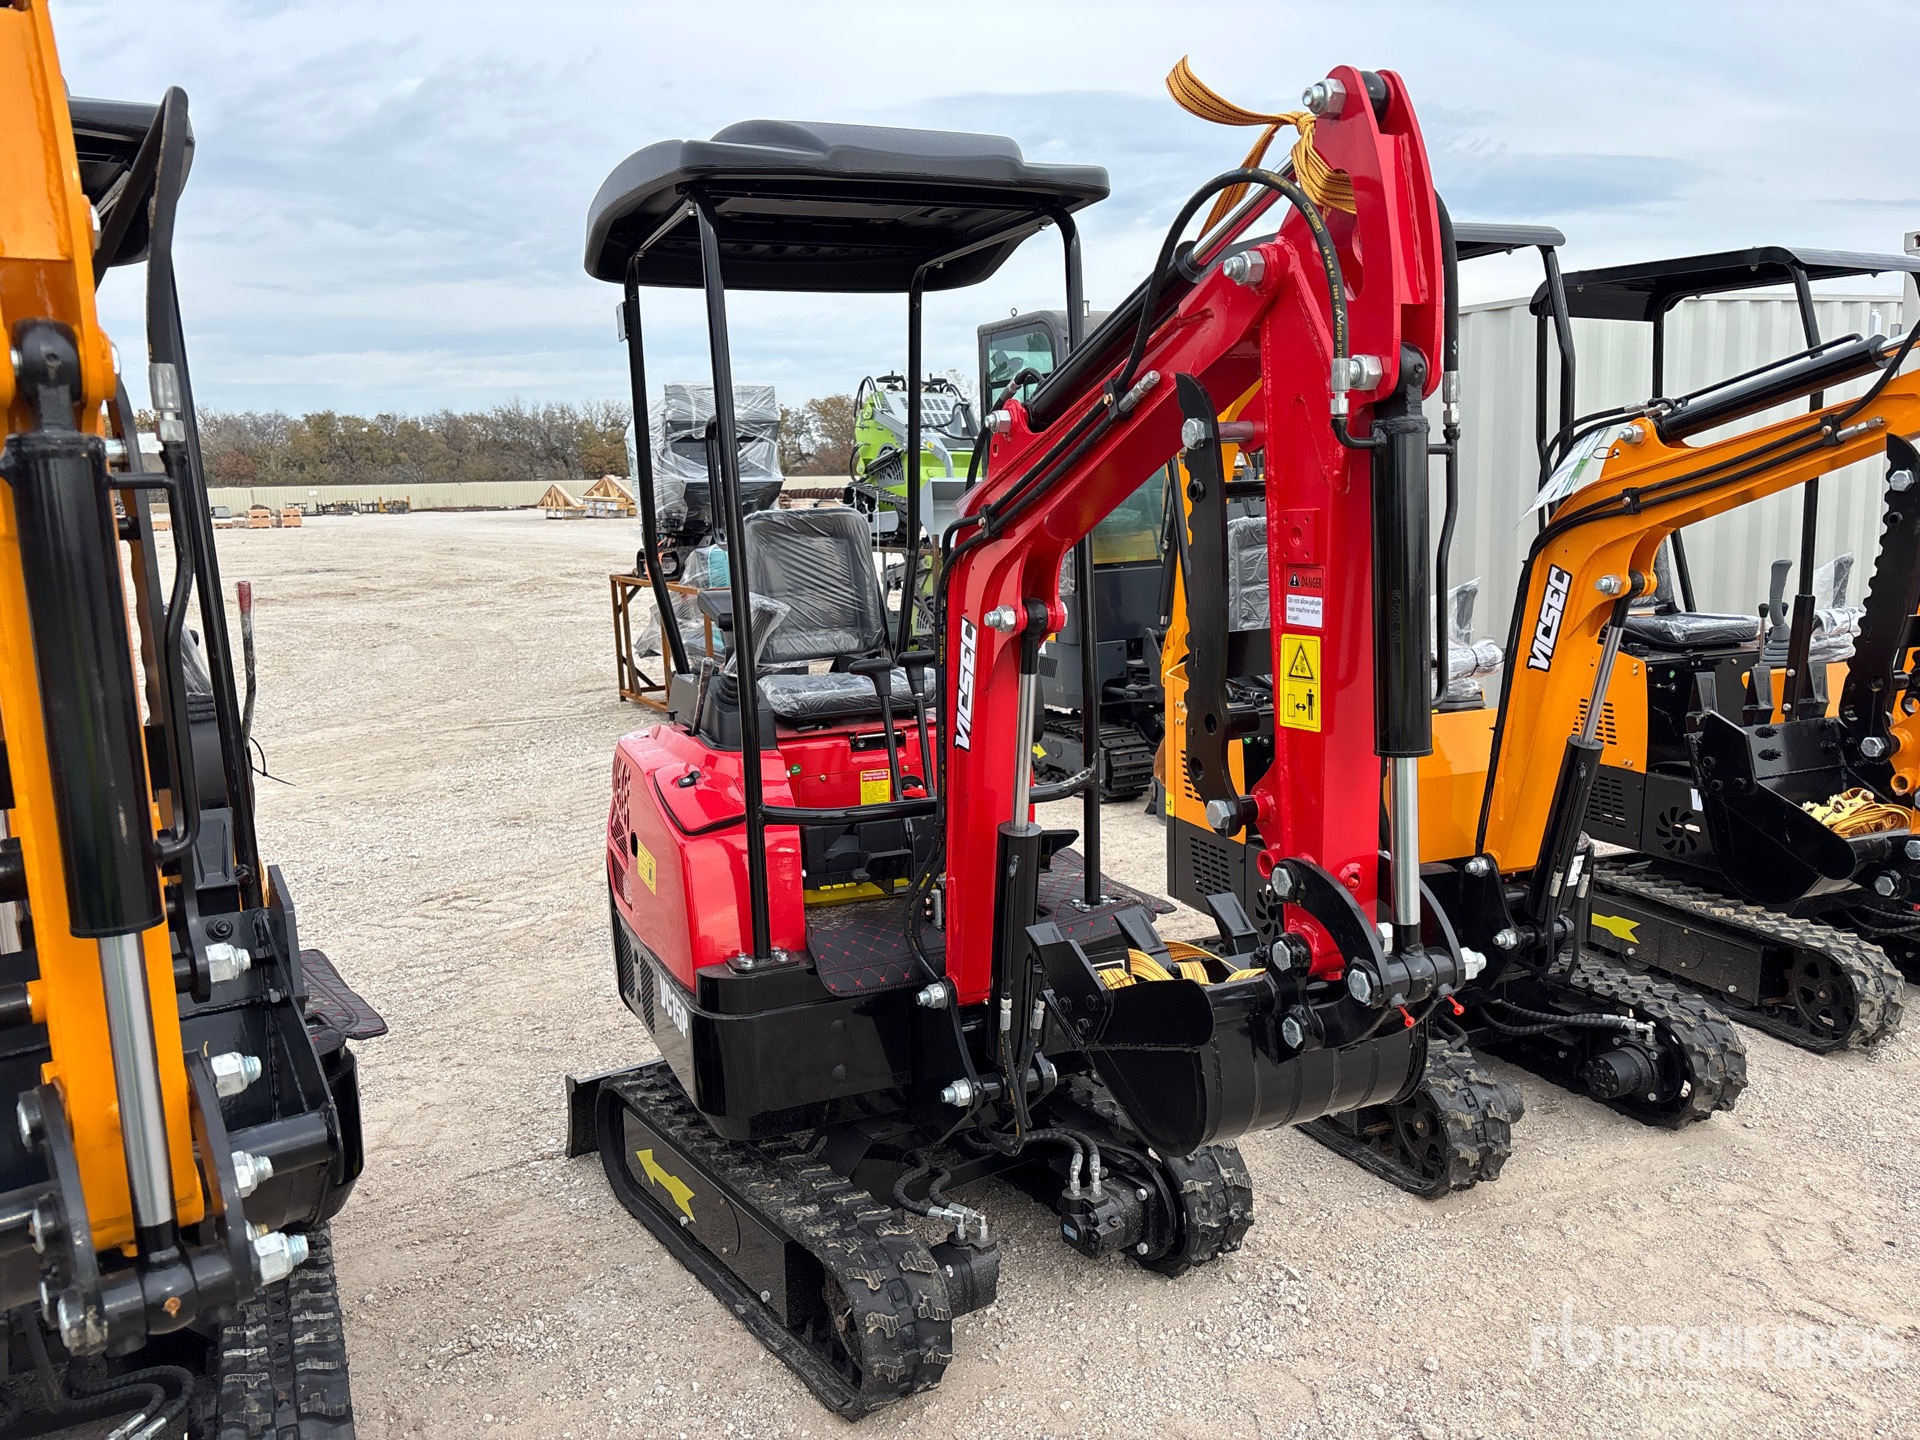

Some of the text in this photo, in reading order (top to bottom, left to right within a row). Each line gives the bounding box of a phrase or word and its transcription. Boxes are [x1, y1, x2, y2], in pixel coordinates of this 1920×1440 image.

[1301, 576, 1322, 589] DANGER
[1308, 599, 1322, 607] people
[1528, 565, 1571, 671] VICSEC
[955, 617, 978, 751] VICSEC
[659, 973, 689, 1039] VC15P
